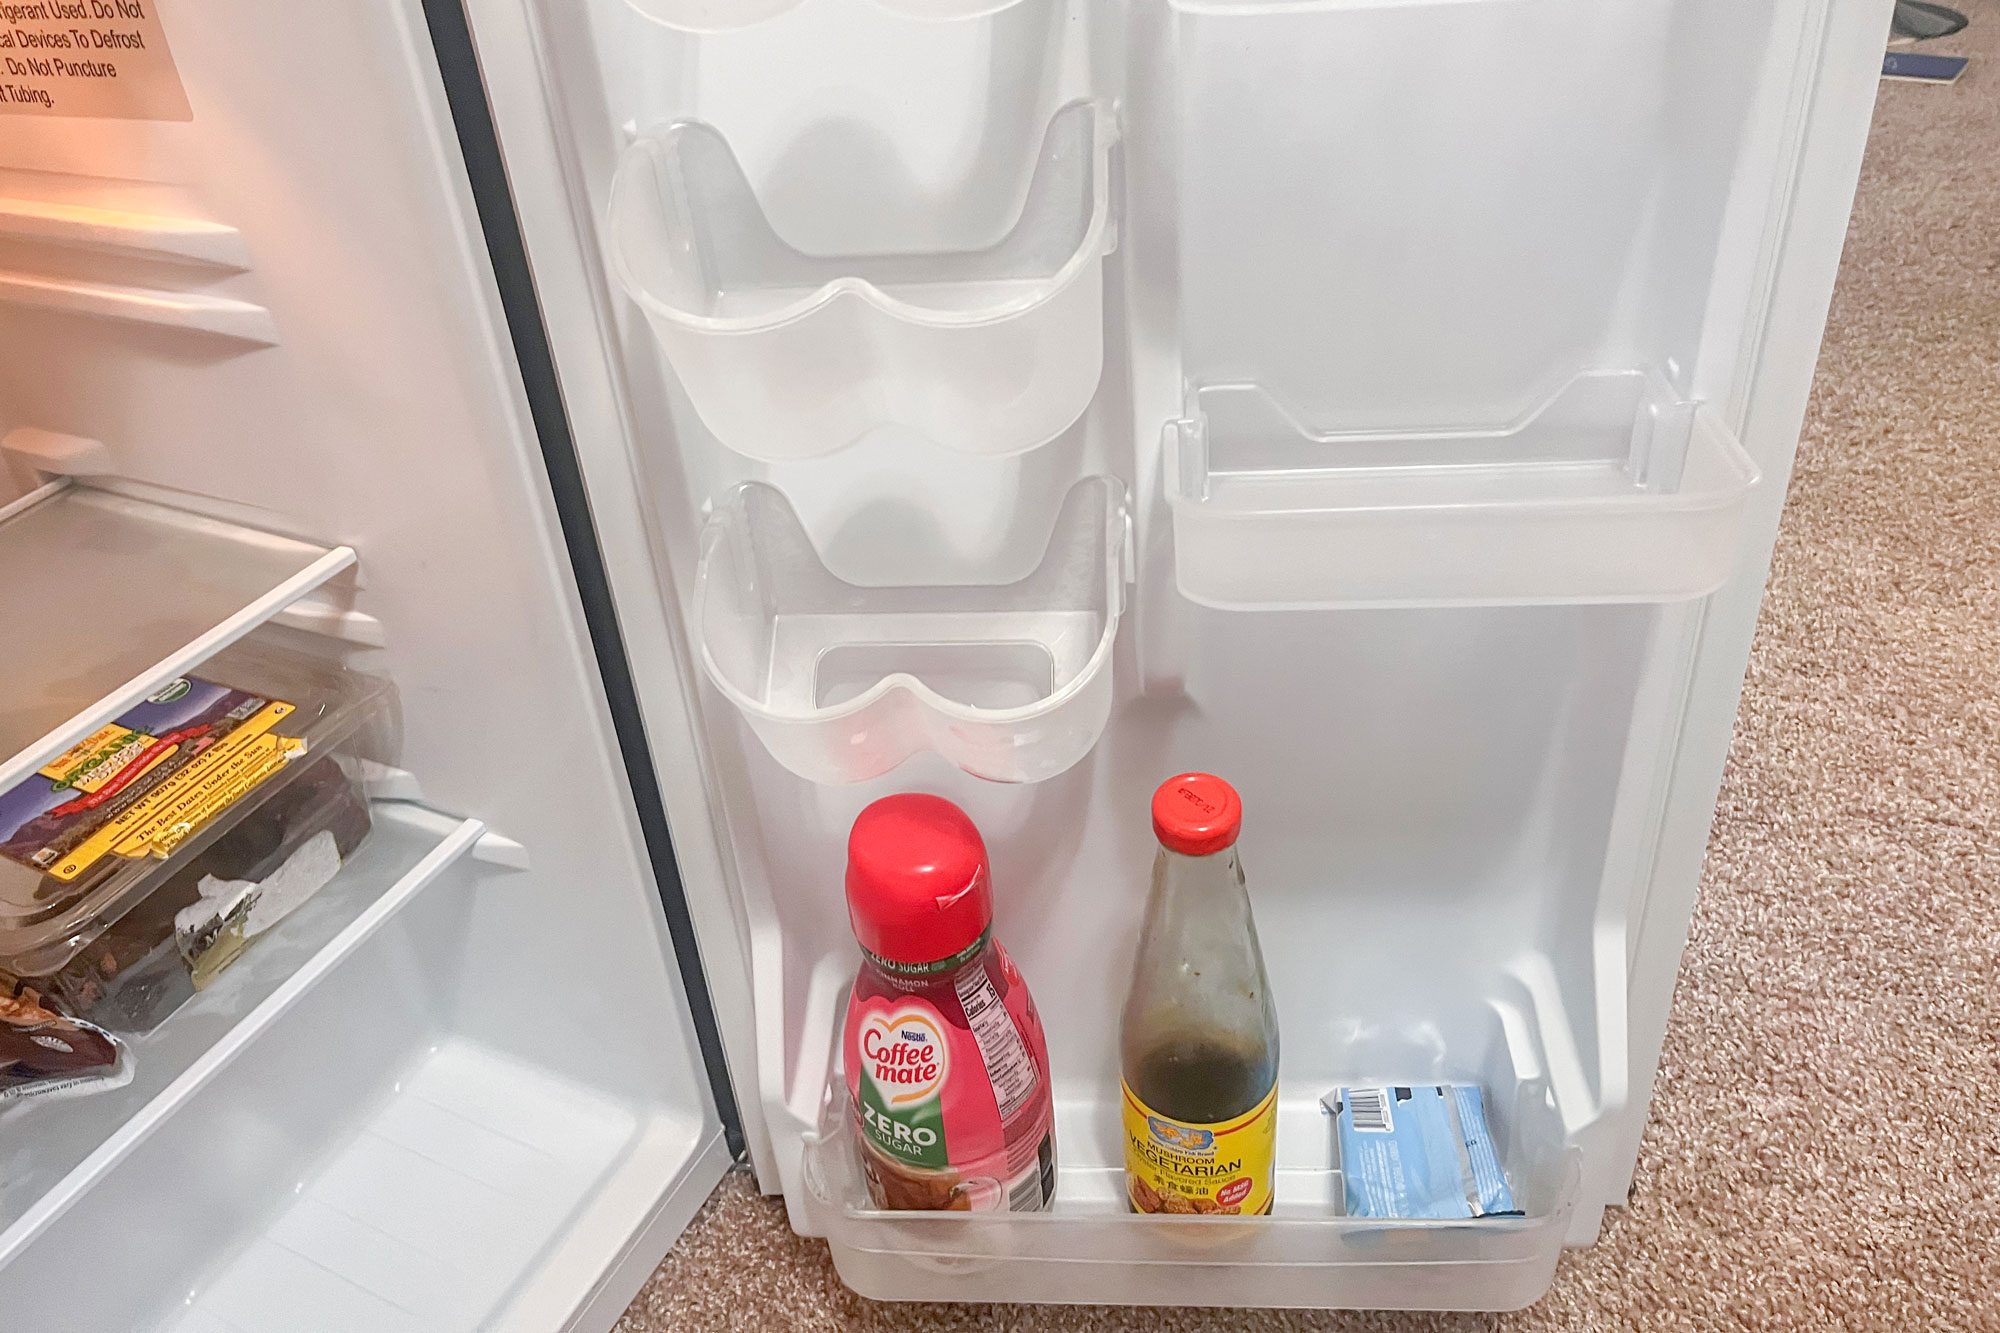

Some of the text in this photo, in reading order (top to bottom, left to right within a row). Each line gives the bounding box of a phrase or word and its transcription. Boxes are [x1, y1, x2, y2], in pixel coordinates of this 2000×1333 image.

[50, 0, 92, 19] Used.
[92, 0, 114, 19] Do
[117, 0, 145, 19] Not
[16, 29, 71, 49] Devices
[69, 29, 90, 49] To
[90, 29, 146, 50] Defrost
[5, 57, 117, 78] Do Not Puncture
[5, 84, 55, 108] Tubing.
[137, 826, 156, 841] The
[156, 810, 177, 827] Best
[177, 790, 203, 811] Dates
[202, 768, 230, 790] Under
[231, 758, 244, 770] the
[244, 745, 263, 759] Sun
[115, 810, 135, 825] NET
[134, 798, 152, 810] WT
[898, 963, 929, 973] SUGAR
[965, 1000, 986, 1017] Calories
[864, 1028, 934, 1066] Coffee
[876, 1063, 937, 1084] mate
[863, 1101, 937, 1147] ZERO
[875, 1130, 922, 1156] SUGAR
[1129, 1129, 1241, 1176] VEGETARIAN
[1147, 1141, 1215, 1164] MUSHROOM
